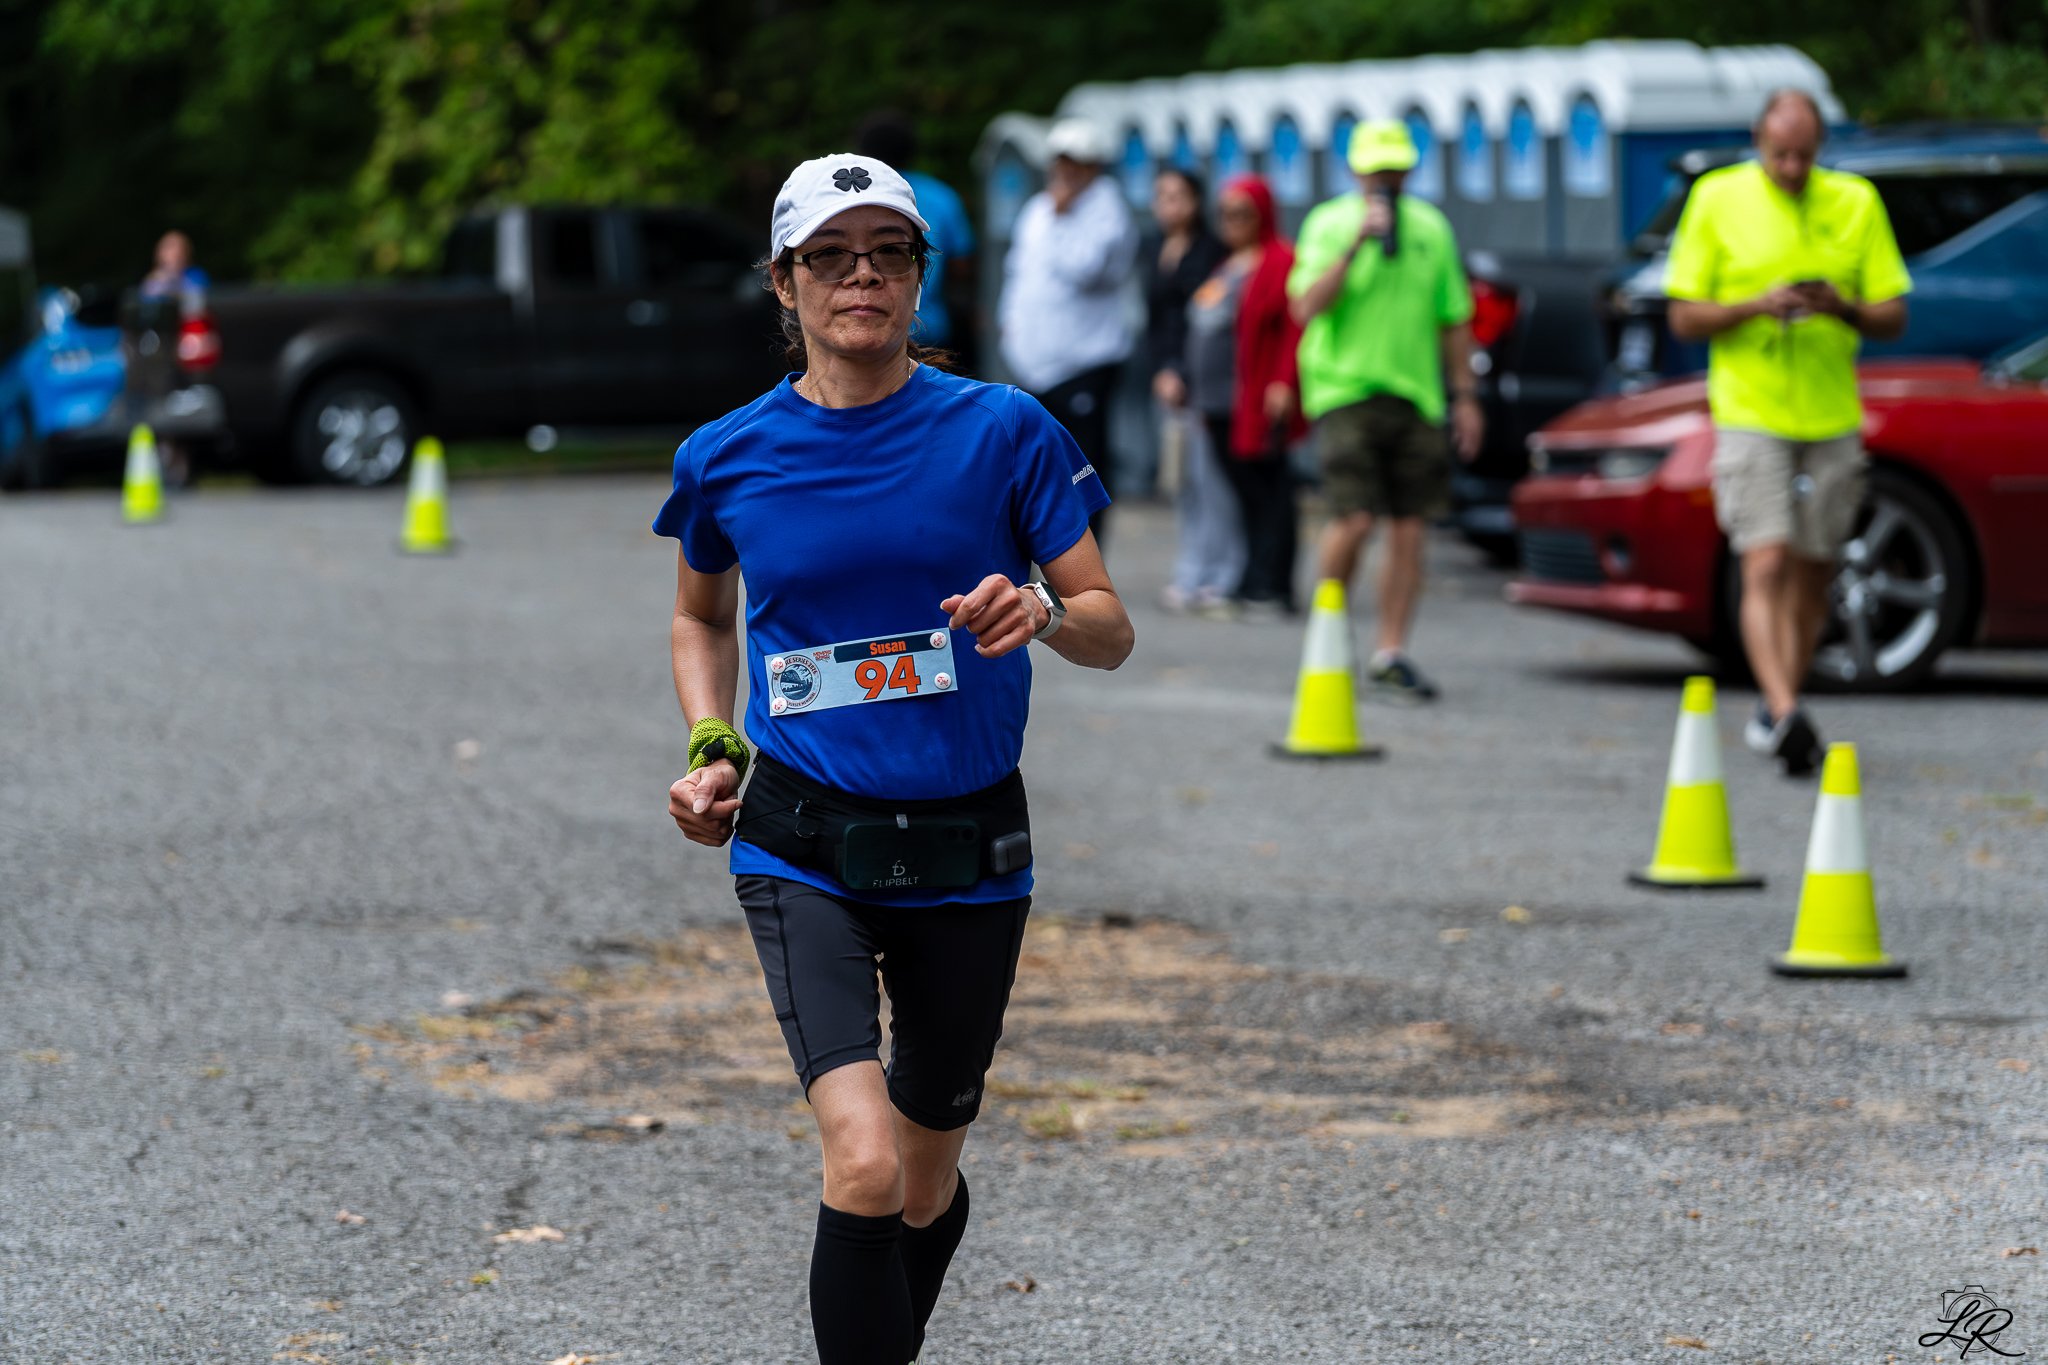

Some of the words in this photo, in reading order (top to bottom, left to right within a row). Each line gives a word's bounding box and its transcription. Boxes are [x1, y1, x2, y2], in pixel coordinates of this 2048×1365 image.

[869, 641, 906, 655] Susan
[855, 655, 921, 700] 94
[873, 876, 919, 887] FLIPBELT
